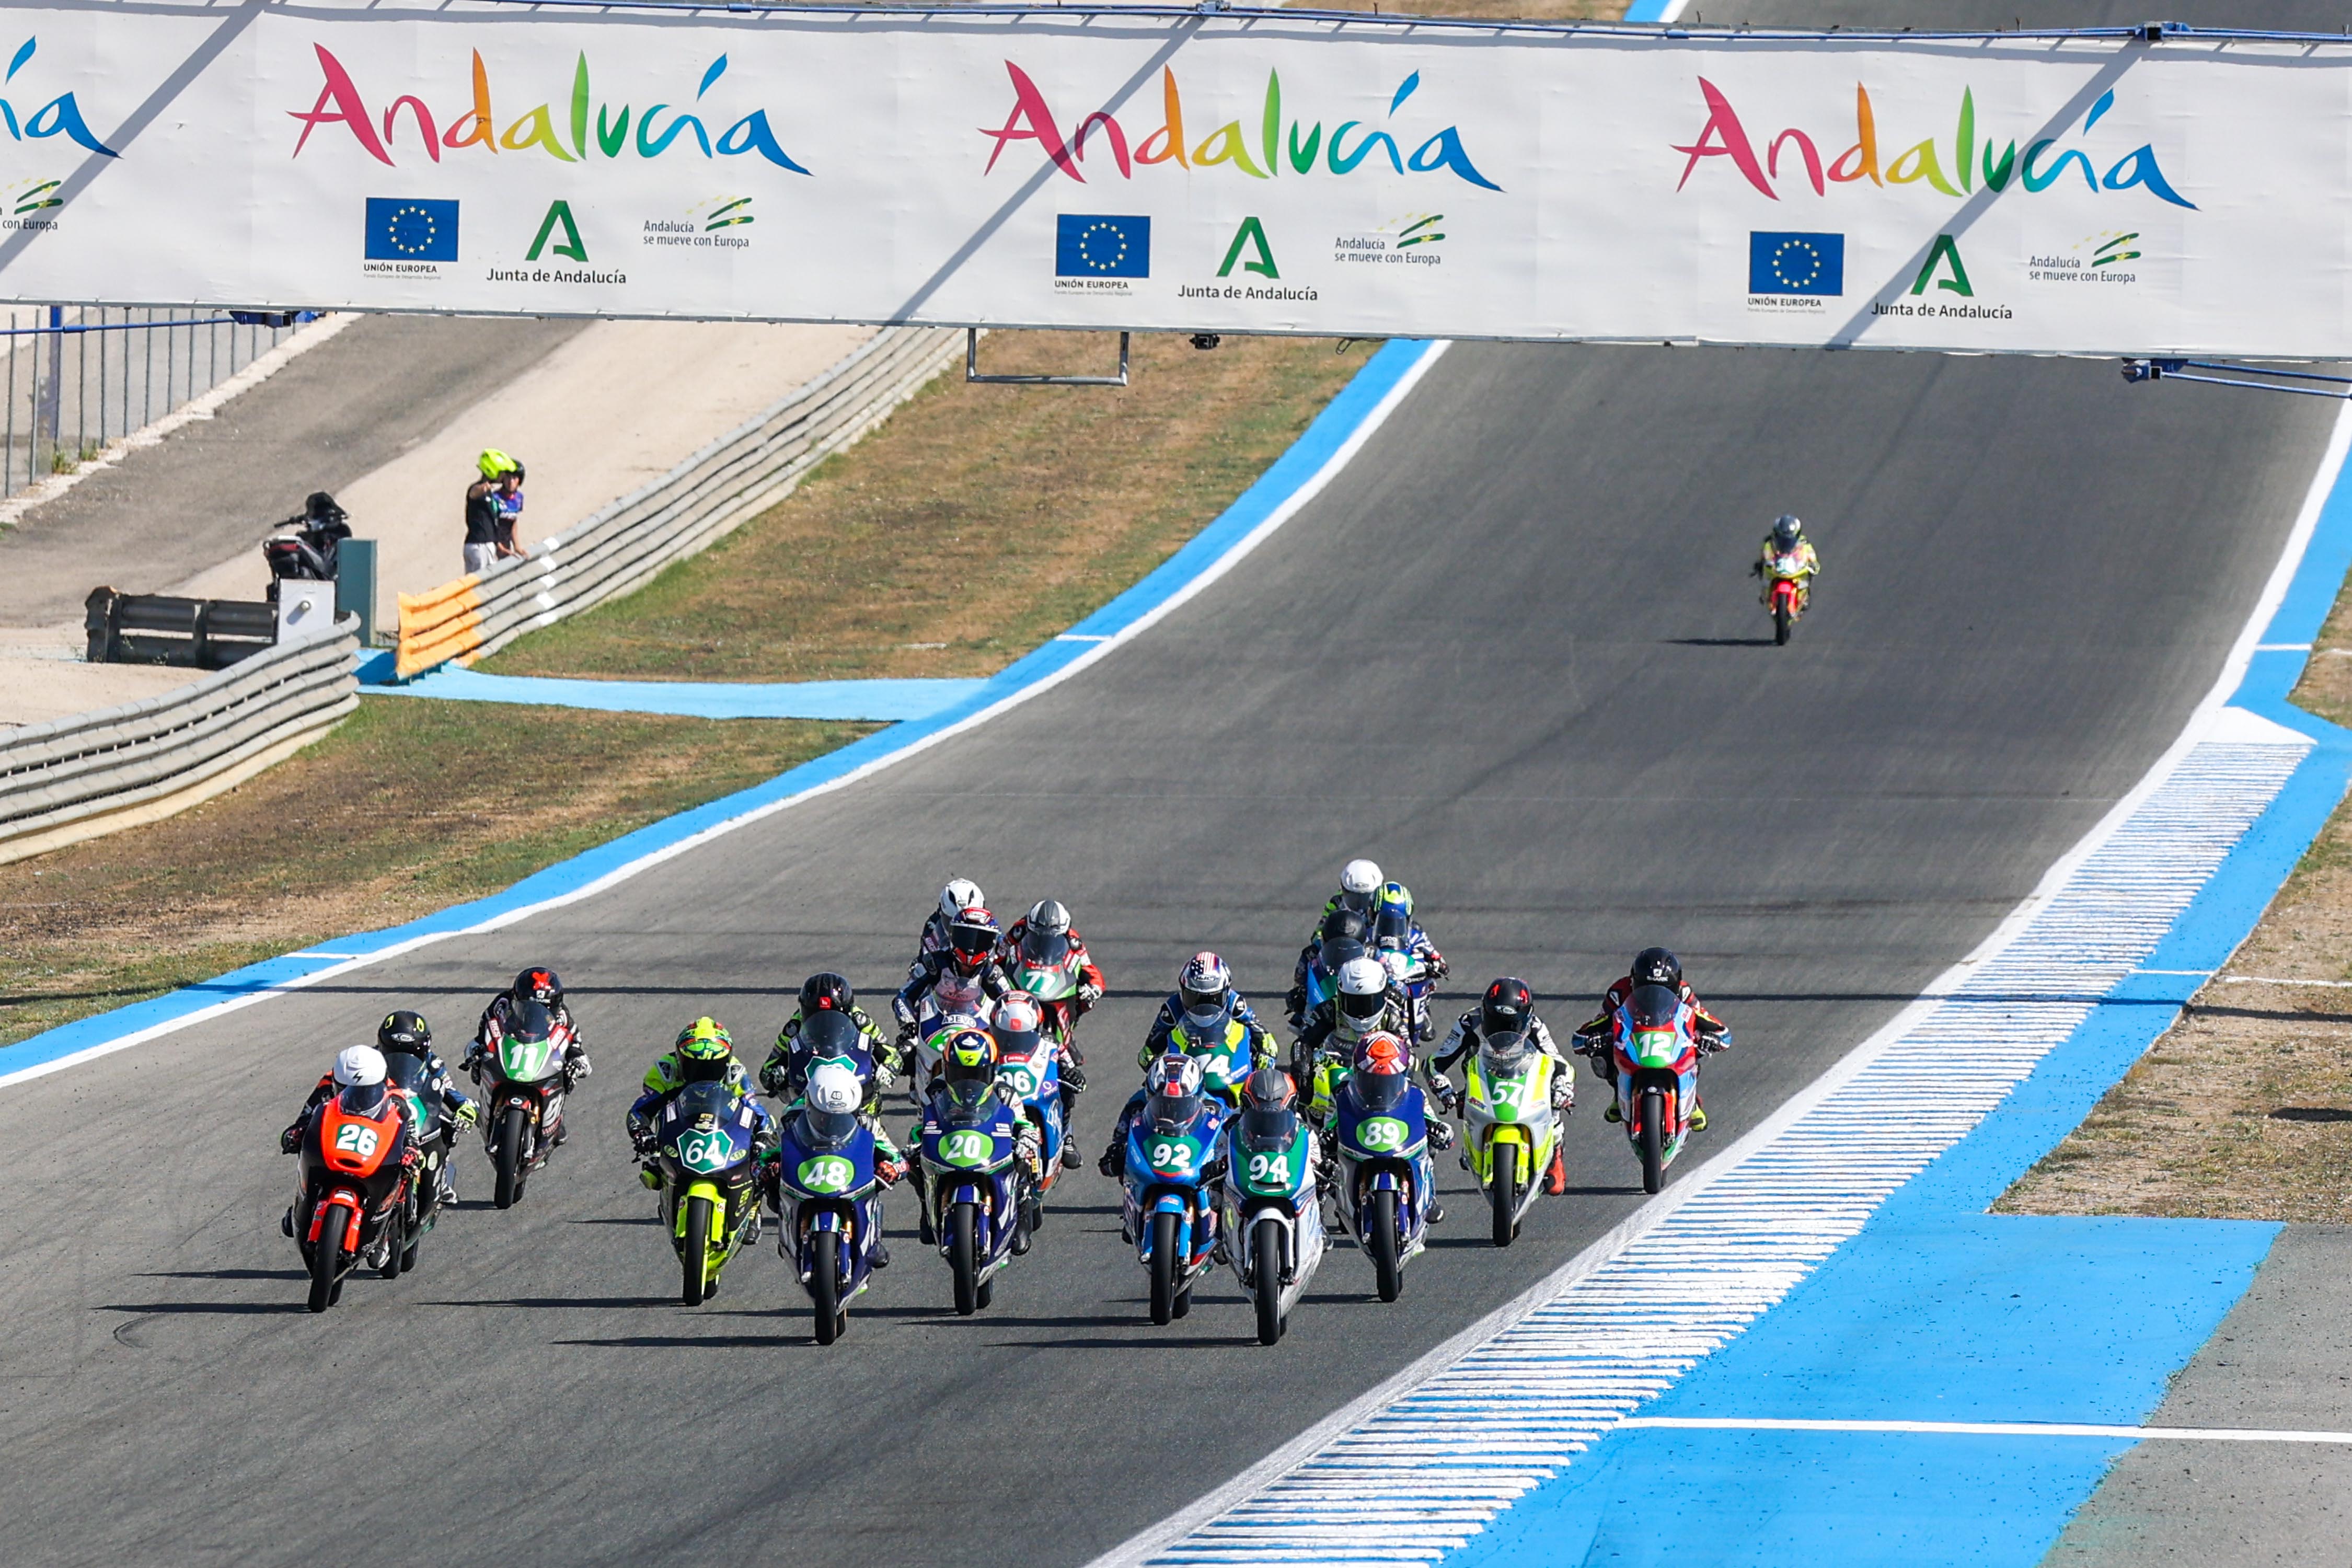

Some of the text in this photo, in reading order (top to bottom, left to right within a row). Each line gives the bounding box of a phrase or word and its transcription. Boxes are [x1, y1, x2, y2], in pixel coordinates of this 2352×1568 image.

[286, 42, 815, 176] Andalucía
[977, 59, 1506, 192] Andalucía
[1670, 75, 2202, 211] Andalucía
[2, 218, 58, 232] con Europa
[643, 220, 694, 233] Andalucía
[643, 235, 749, 250] se mueve con Europa
[1335, 237, 1385, 250] Andalucía
[363, 262, 437, 273] UNIÓN EUROPEA
[1334, 252, 1440, 267] se mueve con Europa
[2029, 255, 2080, 269] Andalucía
[487, 268, 627, 284] Junta de Andalucía
[1054, 279, 1129, 289] UNIÓN EUROPEA
[2029, 271, 2136, 285] se mueve con Europa
[1178, 285, 1318, 301] Junta de Andalucía
[1747, 296, 1822, 307] UNIÓN EUROPEA
[1871, 303, 2013, 319] Junta de Andalucía
[1639, 1033, 1672, 1062] 12
[510, 1044, 538, 1071] 11
[1492, 1081, 1524, 1107] 57
[336, 1124, 378, 1157] 26
[1364, 1122, 1400, 1146] 89
[686, 1139, 720, 1165] 64
[946, 1135, 981, 1159] 20
[1152, 1144, 1191, 1167] 92
[804, 1161, 846, 1186] 48
[1249, 1155, 1290, 1183] 94
